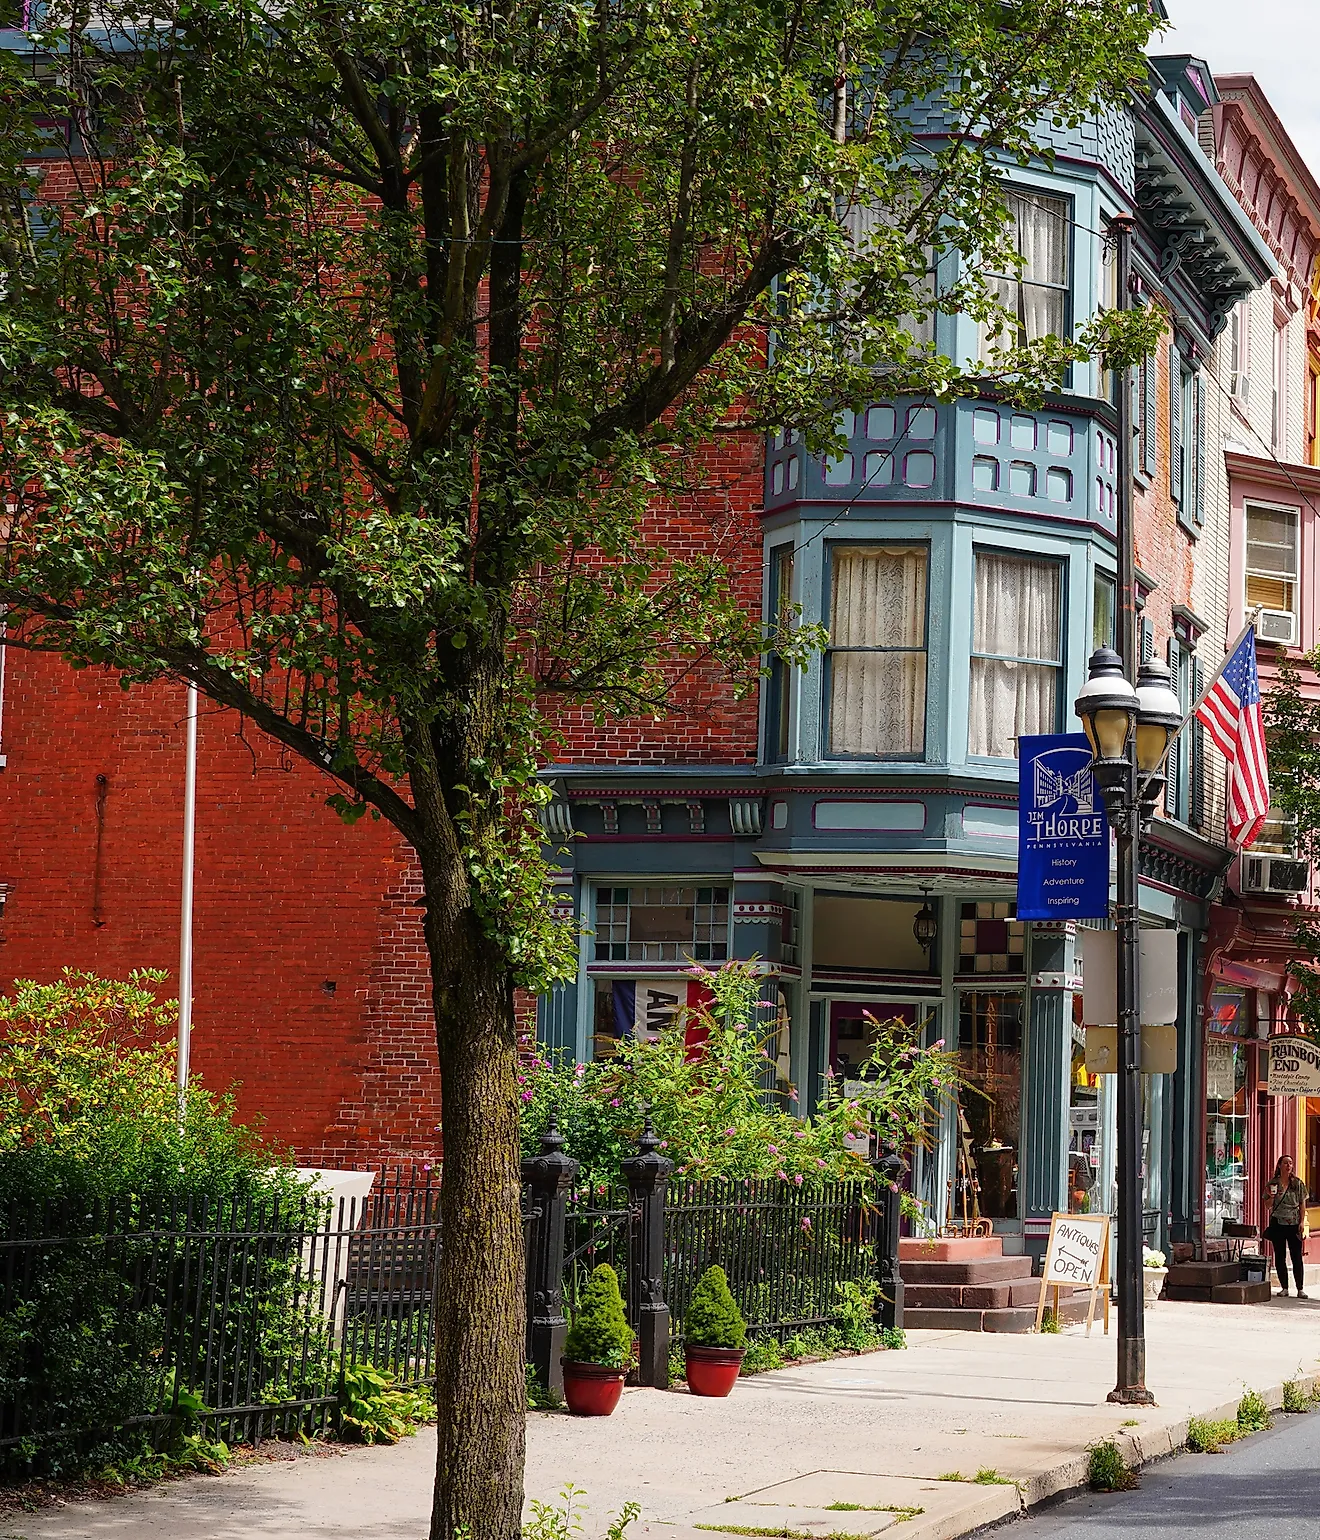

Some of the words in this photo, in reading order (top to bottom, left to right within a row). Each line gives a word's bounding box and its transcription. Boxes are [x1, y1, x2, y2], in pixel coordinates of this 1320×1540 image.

[1027, 811, 1045, 824] JIM
[1034, 817, 1102, 842] THORPE
[1027, 840, 1102, 849] PENNSYLVANIA
[1051, 857, 1077, 868] History
[1043, 876, 1085, 886] Adventure
[1047, 895, 1080, 906] Inspiring
[985, 1001, 996, 1090] ANTIQUES
[1273, 1059, 1300, 1071] END
[1054, 1258, 1092, 1283] OPEN
